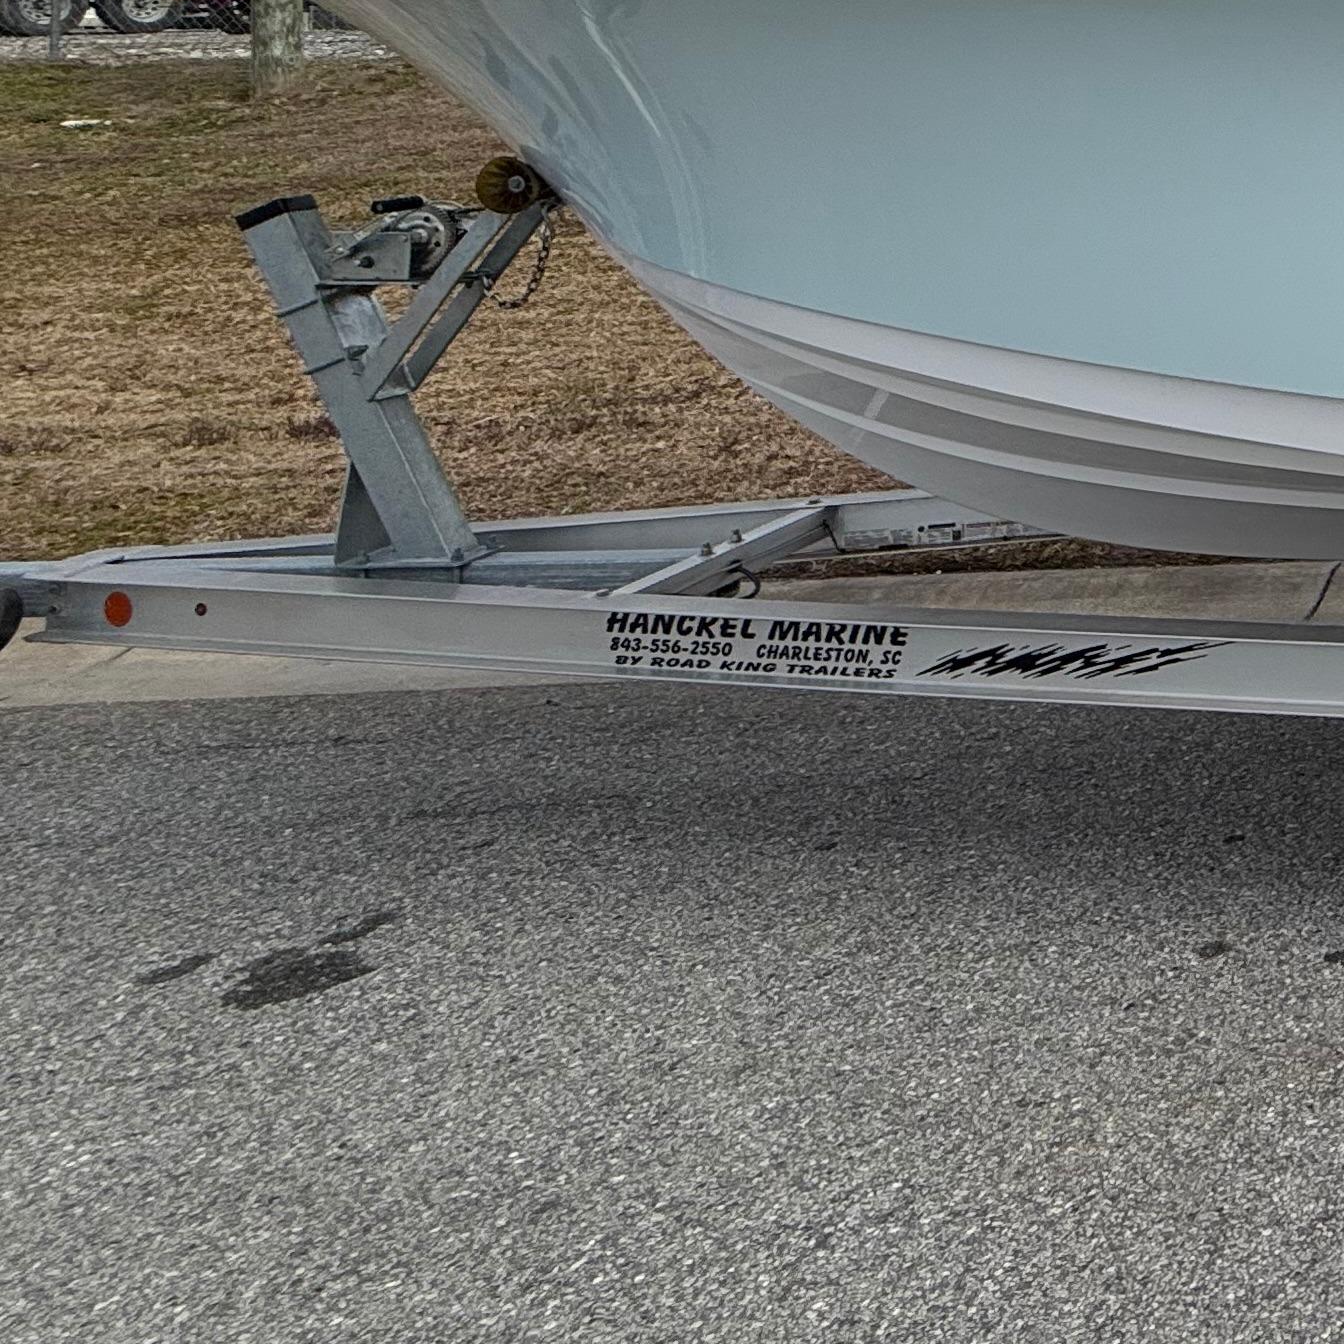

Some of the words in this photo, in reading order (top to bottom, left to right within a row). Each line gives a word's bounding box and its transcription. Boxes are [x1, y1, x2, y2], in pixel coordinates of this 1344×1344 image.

[605, 611, 757, 640] HANCKEL
[767, 619, 911, 647] MARINE
[609, 636, 734, 657] 843-556-2550
[756, 643, 874, 667] CHARLESTON,
[879, 650, 903, 666] SC
[614, 655, 644, 666] BY
[649, 656, 712, 670] ROAD
[719, 659, 778, 674] KING
[786, 663, 898, 679] TRAILERS
